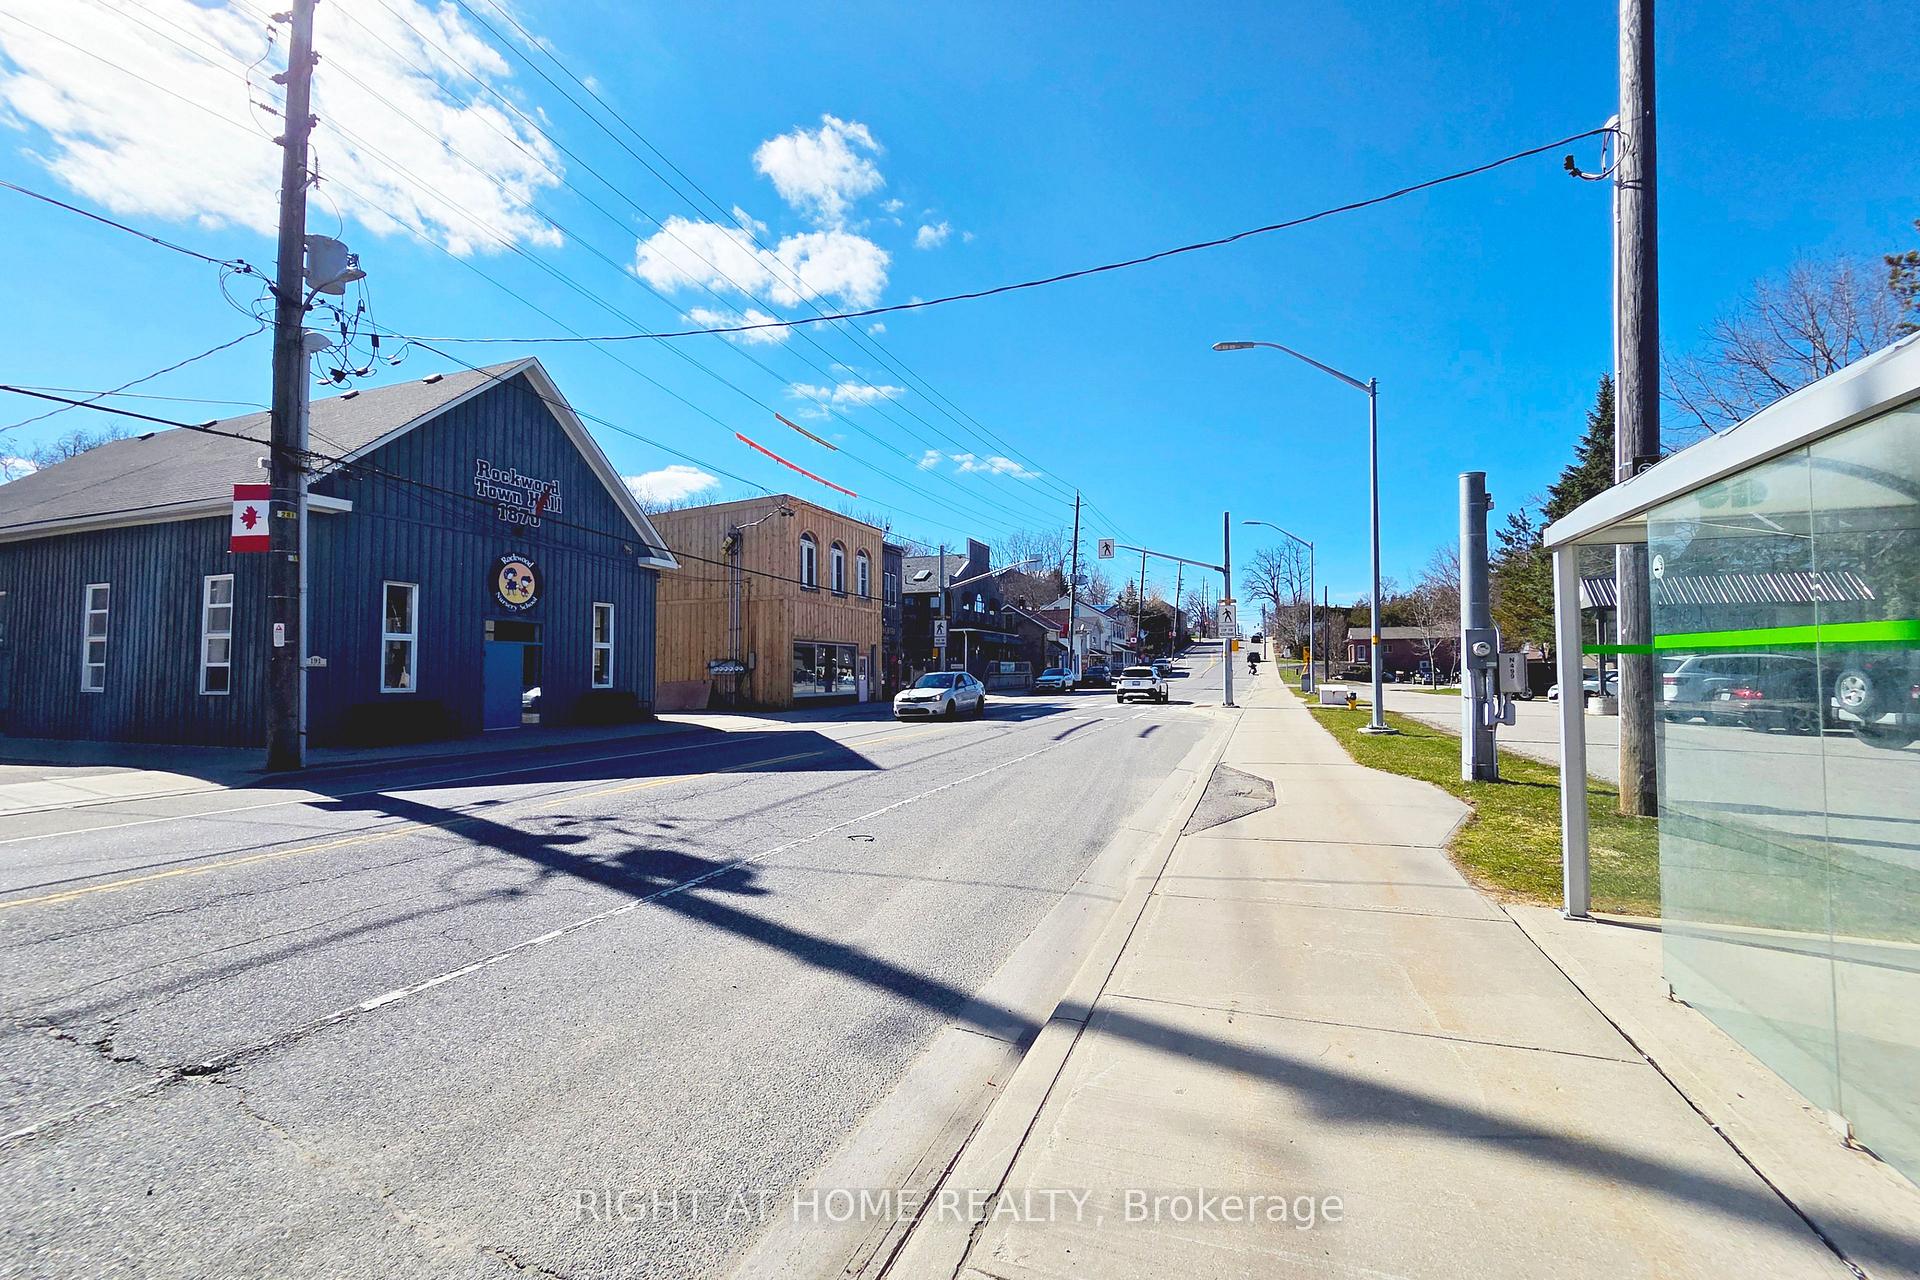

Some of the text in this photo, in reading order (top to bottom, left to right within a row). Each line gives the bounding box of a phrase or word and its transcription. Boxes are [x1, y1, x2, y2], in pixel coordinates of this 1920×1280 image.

[477, 459, 560, 496] Rockwood
[474, 477, 522, 505] Town
[498, 503, 540, 527] 1870
[501, 553, 535, 568] Rockwood
[519, 596, 538, 610] School
